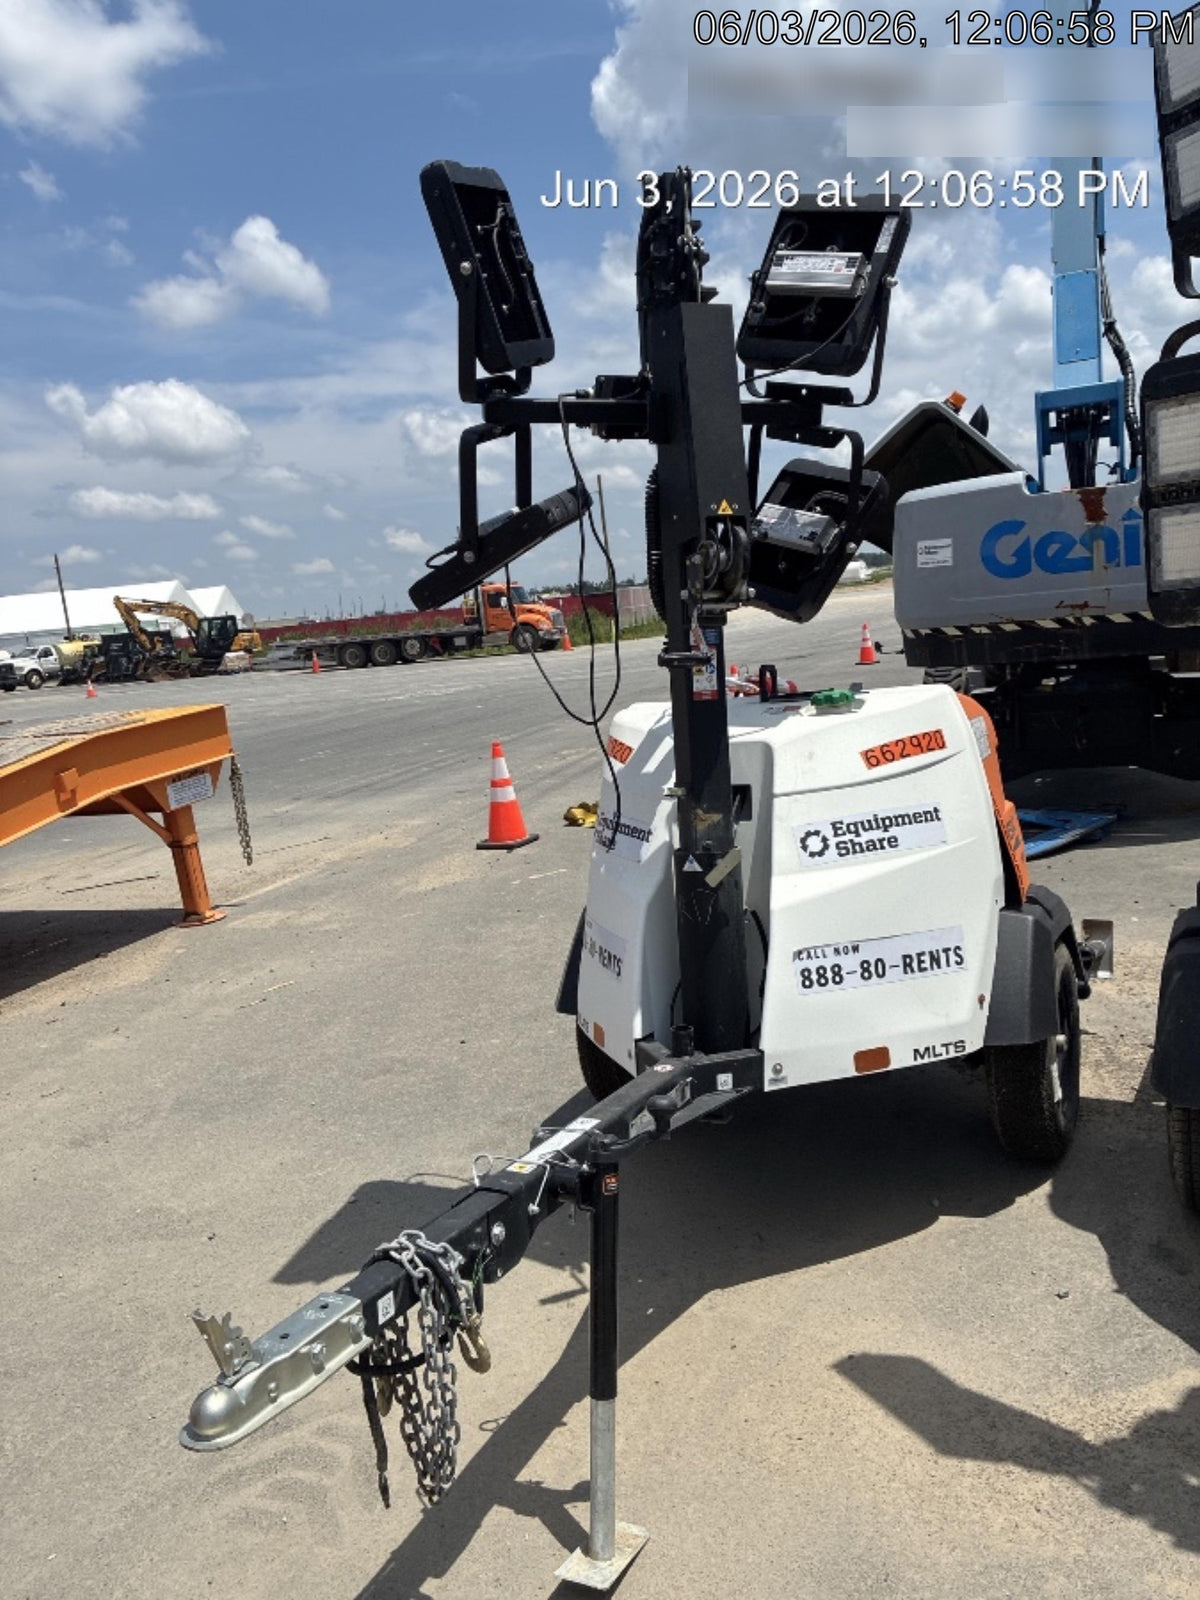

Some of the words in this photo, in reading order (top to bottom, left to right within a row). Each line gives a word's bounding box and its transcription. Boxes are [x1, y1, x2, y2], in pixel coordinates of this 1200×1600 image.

[979, 507, 1144, 580] Geni
[864, 729, 946, 768] 662920
[829, 806, 942, 838] Equipment
[834, 834, 900, 858] Share
[797, 948, 828, 962] CALL
[833, 943, 861, 957] NOW
[800, 944, 965, 990] 888-80-RENTS
[912, 1039, 967, 1062] MLTS
